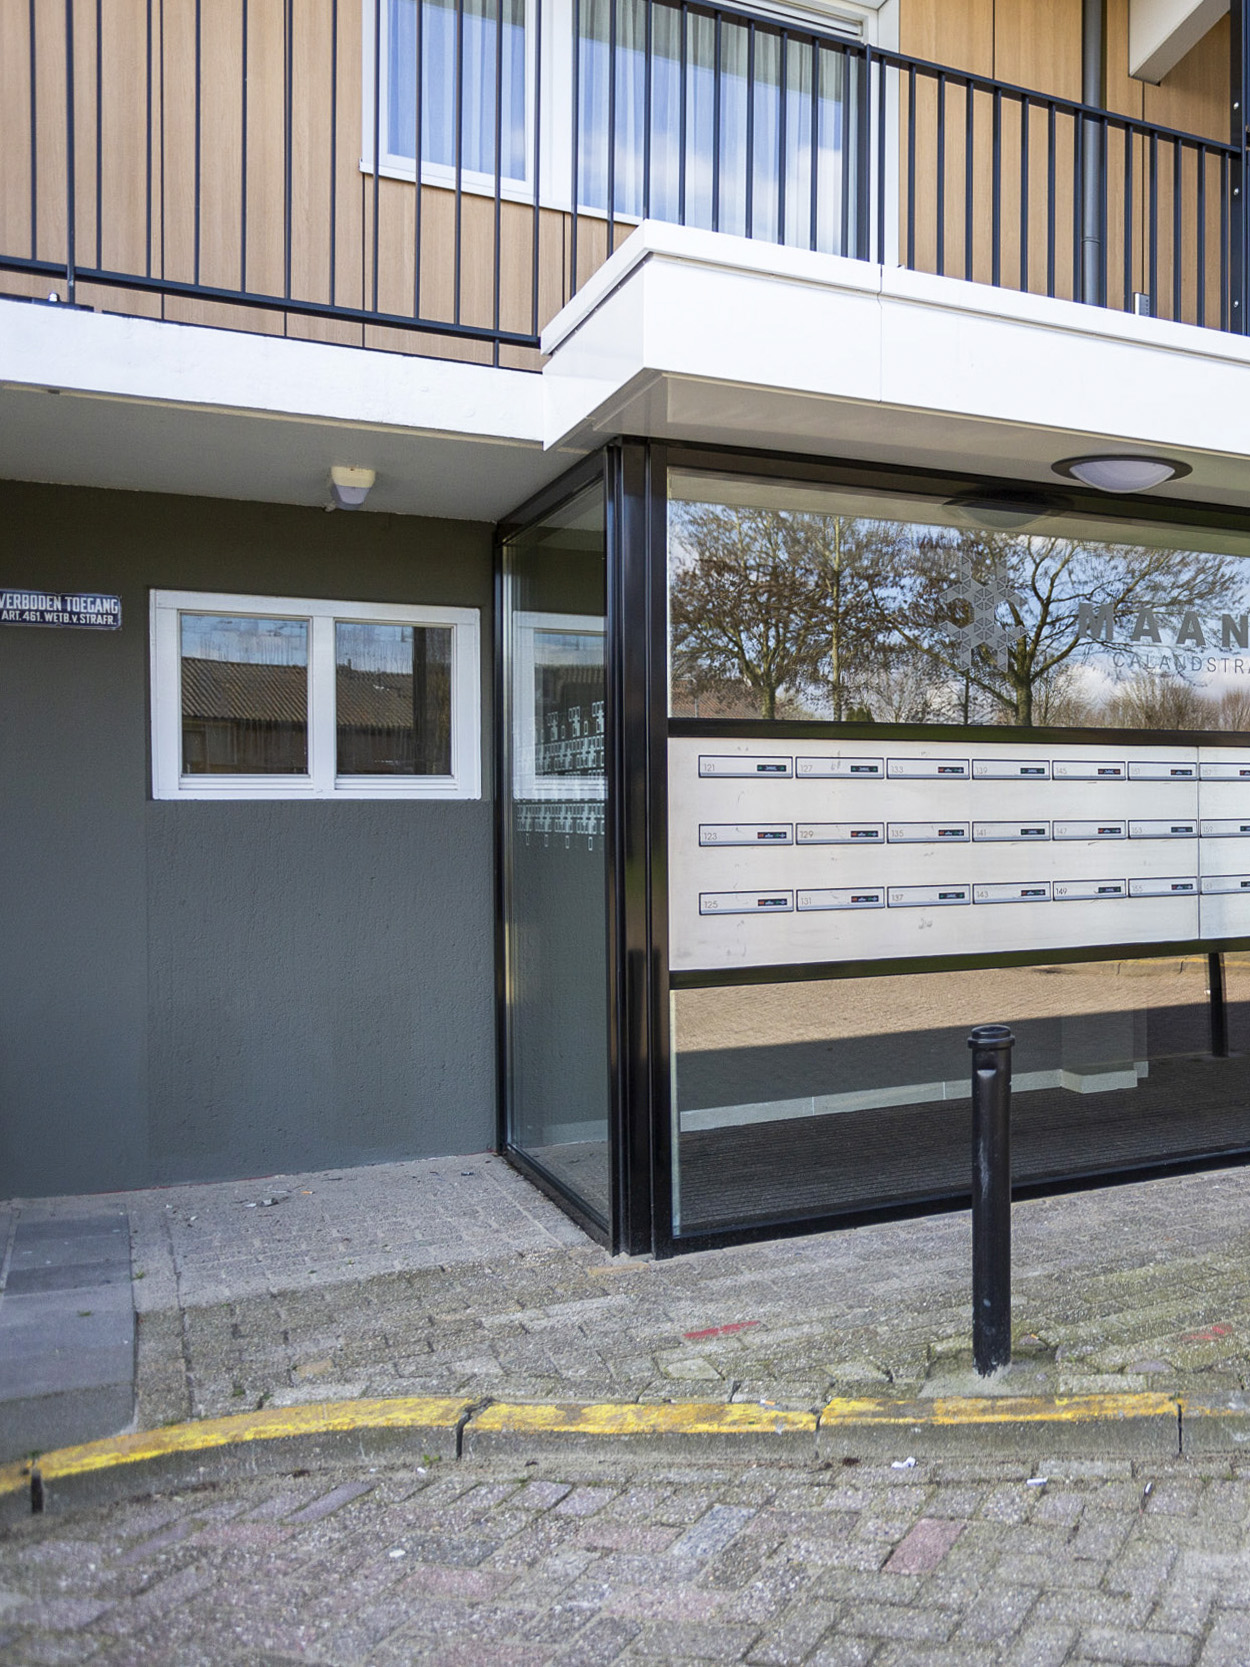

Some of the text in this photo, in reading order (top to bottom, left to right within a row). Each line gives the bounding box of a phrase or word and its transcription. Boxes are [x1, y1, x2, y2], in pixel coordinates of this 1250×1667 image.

[0, 593, 118, 614] VERBODEN TOEGANG
[1, 610, 21, 621] ART.
[22, 611, 43, 622] 461.
[79, 614, 117, 625] STRAFR.
[704, 763, 715, 772] 121
[800, 764, 813, 772] 127
[891, 766, 904, 774] 133
[1056, 767, 1068, 775] 145
[704, 832, 718, 841] 123
[799, 830, 814, 839] 129
[891, 829, 904, 838] 135
[976, 829, 987, 837] 141
[976, 890, 989, 898] 143
[1056, 887, 1068, 896] 149
[800, 897, 812, 905] 131
[891, 893, 904, 902] 137
[704, 900, 718, 909] 125
